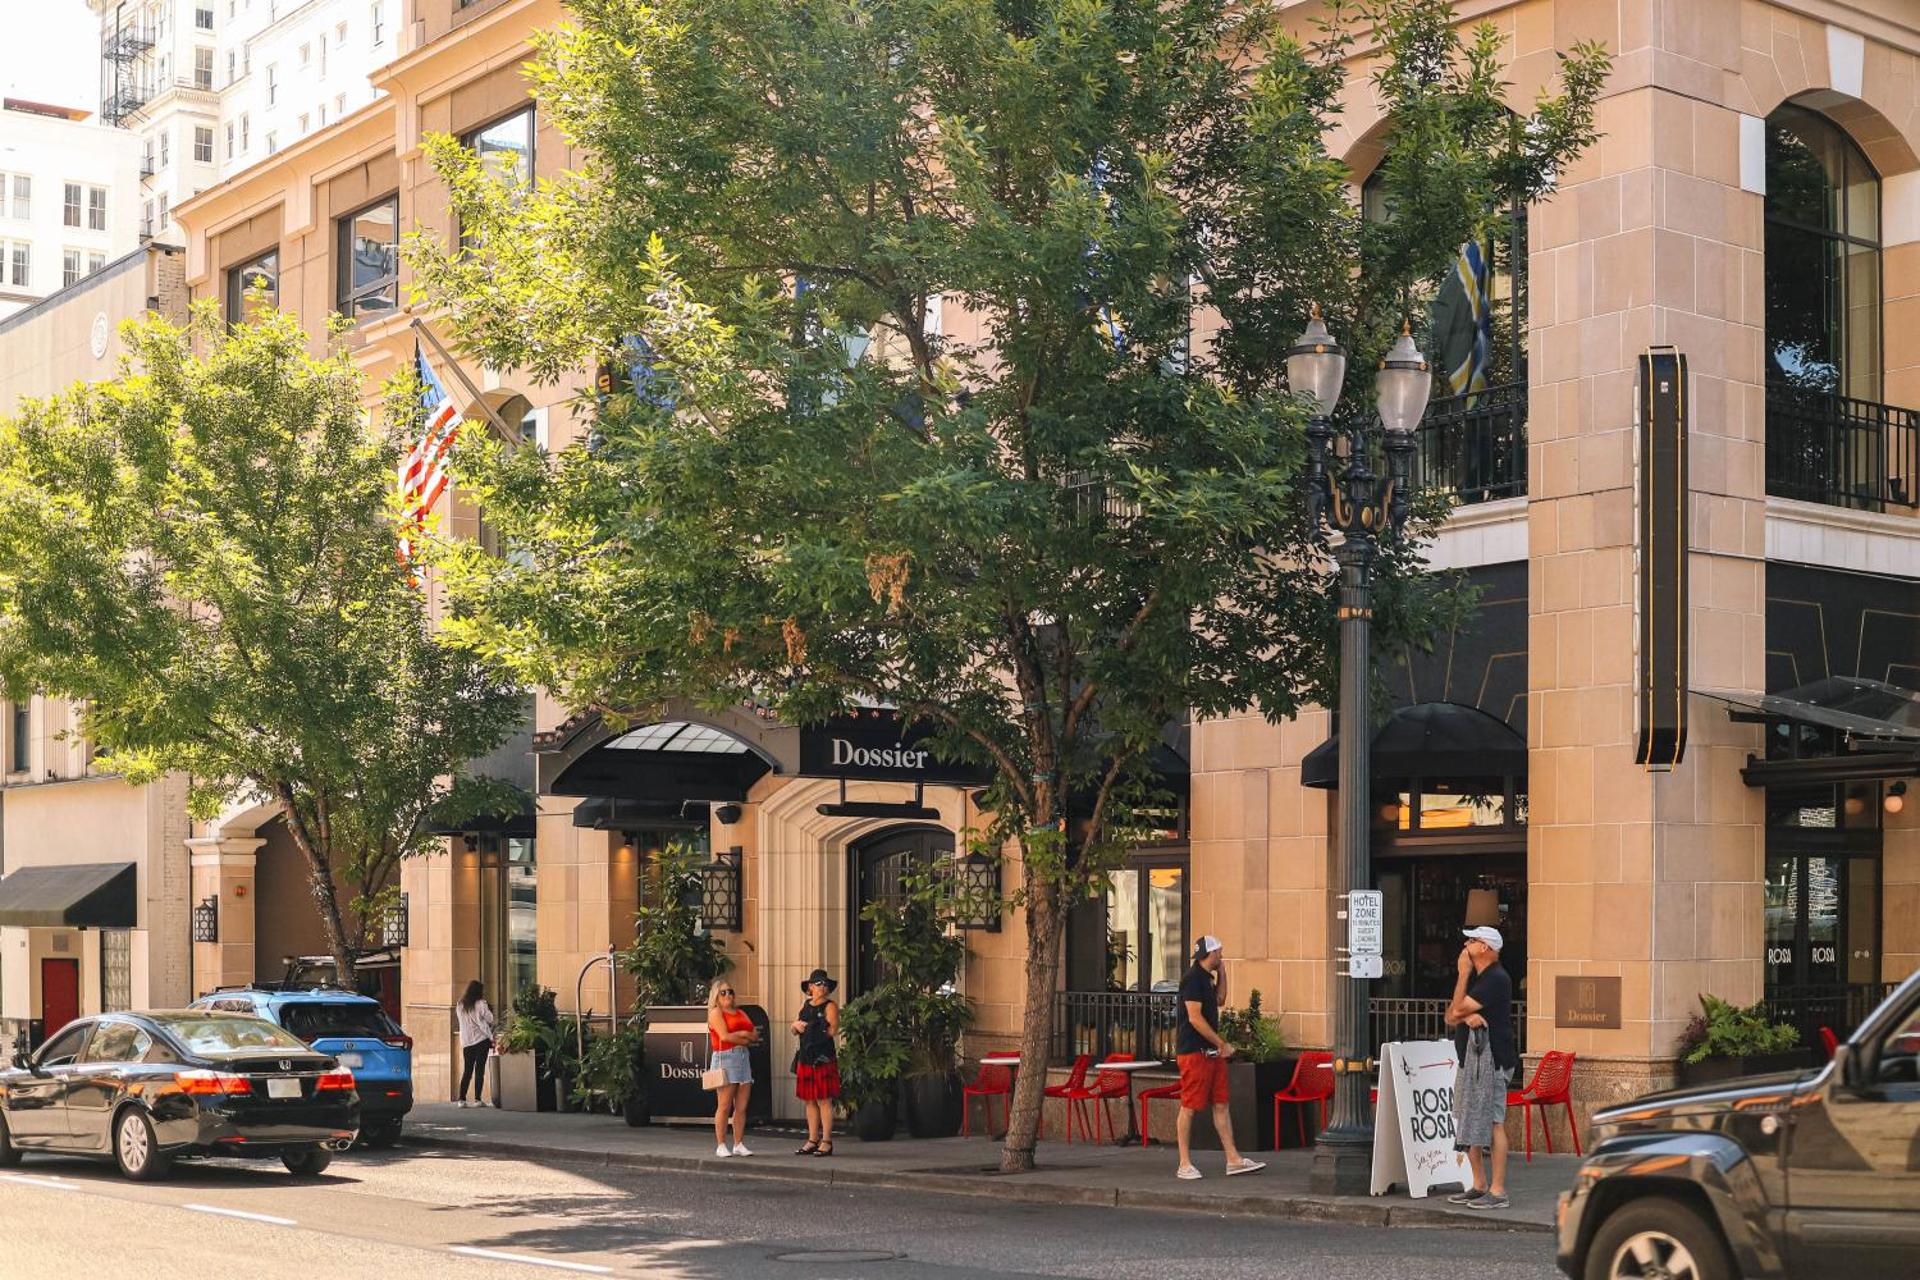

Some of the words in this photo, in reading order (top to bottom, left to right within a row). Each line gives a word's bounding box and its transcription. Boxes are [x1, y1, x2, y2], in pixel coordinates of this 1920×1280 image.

[832, 738, 929, 769] Dossier
[1353, 896, 1379, 907] HOTEL
[1355, 908, 1377, 918] ZONE
[1768, 948, 1792, 965] ROSA
[1812, 947, 1835, 964] ROSA
[1410, 1113, 1456, 1143] ROSA
